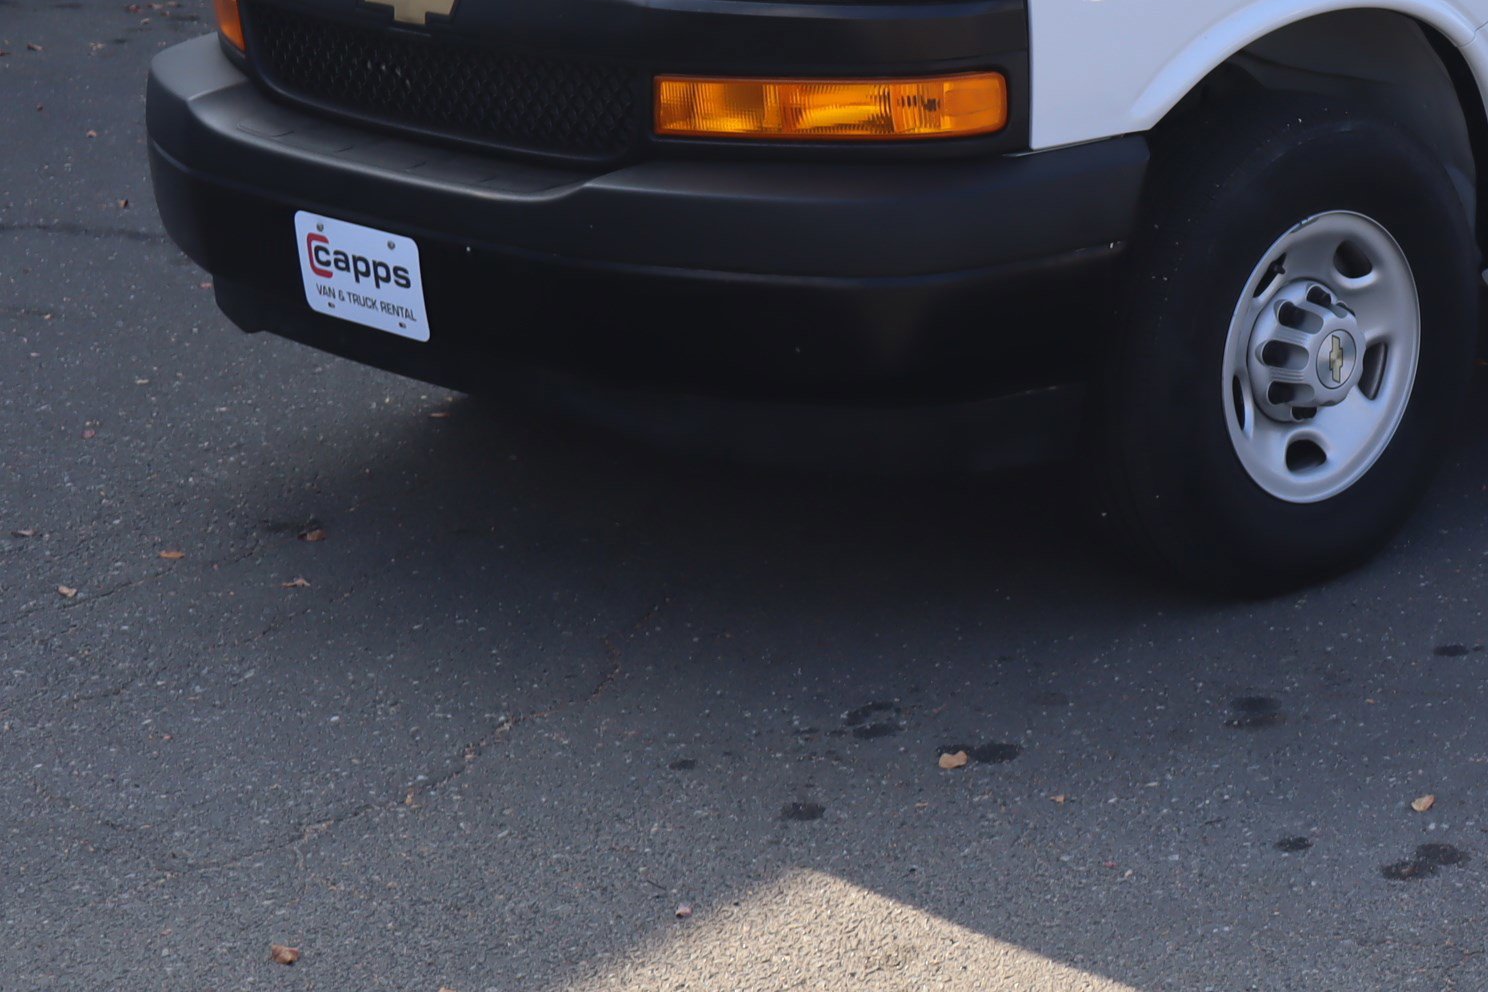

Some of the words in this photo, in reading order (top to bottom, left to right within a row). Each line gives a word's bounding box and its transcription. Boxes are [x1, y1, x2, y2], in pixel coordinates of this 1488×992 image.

[316, 283, 336, 299] VAN
[338, 290, 345, 302] &
[347, 292, 378, 310] TRUCK
[380, 301, 417, 322] RENTAL
